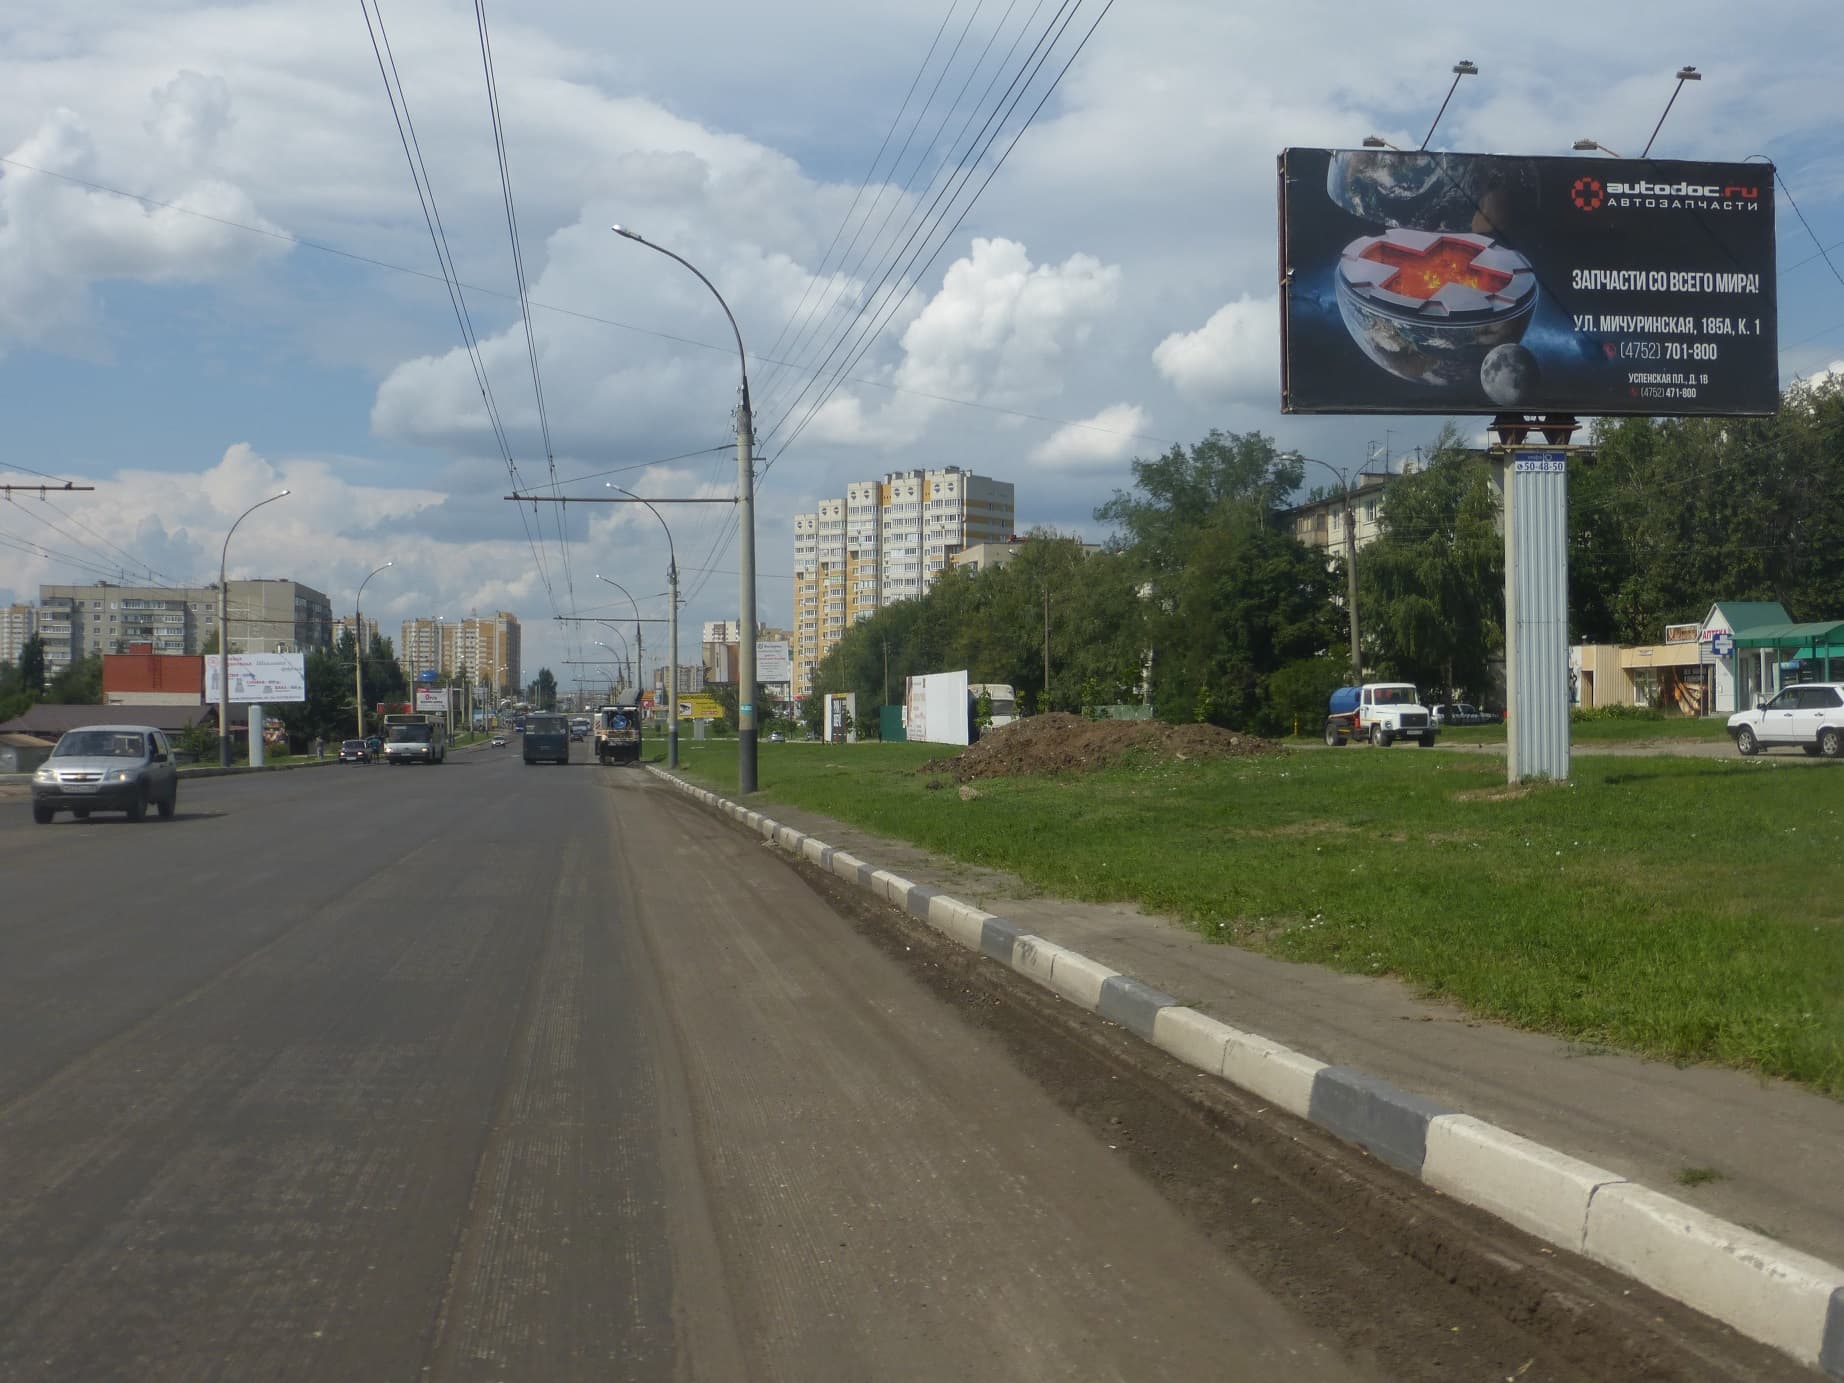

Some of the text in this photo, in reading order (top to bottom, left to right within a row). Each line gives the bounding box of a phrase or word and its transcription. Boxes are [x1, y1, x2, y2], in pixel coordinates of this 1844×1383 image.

[1606, 181, 1758, 198] autodoc.ru
[1607, 198, 1758, 211] АВТОЗАПЧАСТИ
[1572, 269, 1759, 294] ЗАПЧАСТИ СО ВСЕГО МИРА!
[1573, 314, 1760, 336] УЛ. МИЧУРИНСКАЯ, 185А, К. 1
[1620, 341, 1718, 360] (4752) 701-800
[1628, 372, 1671, 384] УСПЕНСКАЯ
[1640, 387, 1697, 398] (4752) 471-800
